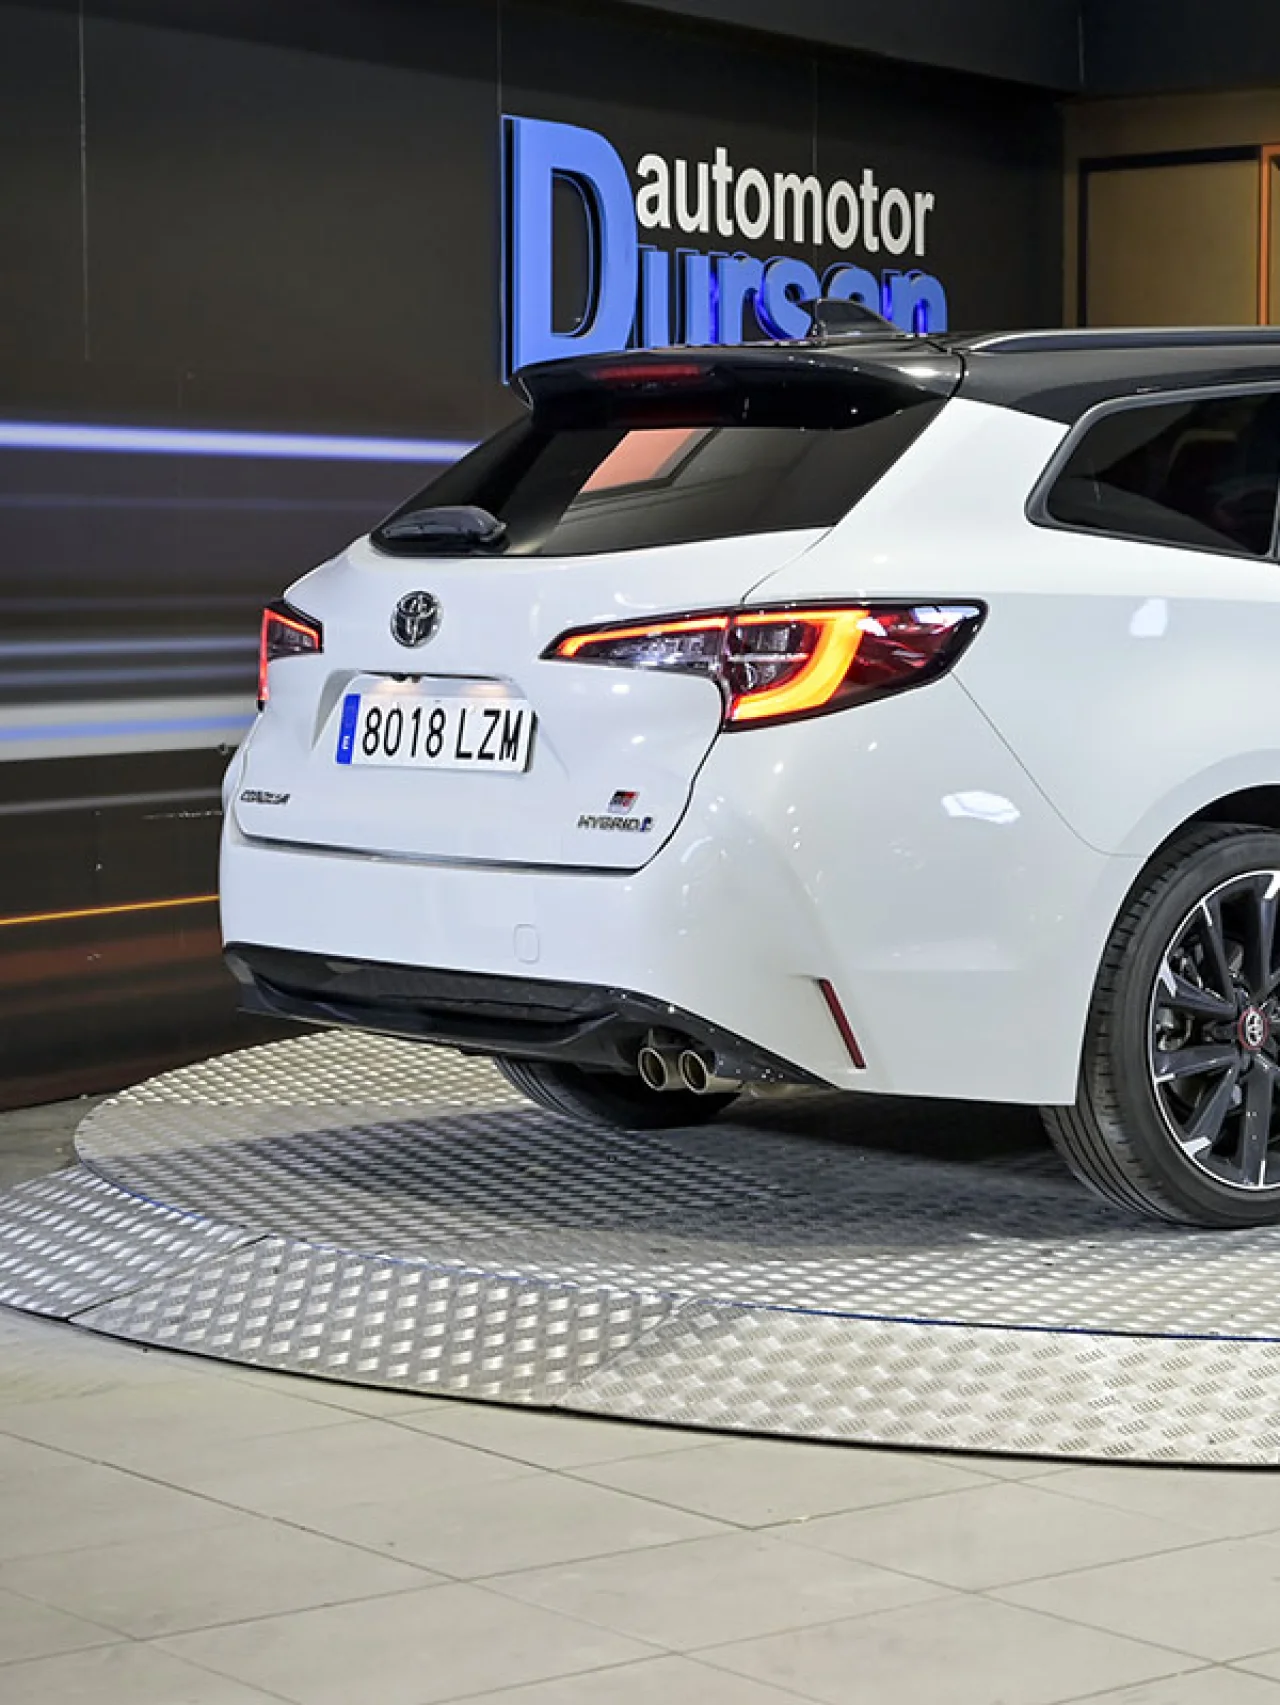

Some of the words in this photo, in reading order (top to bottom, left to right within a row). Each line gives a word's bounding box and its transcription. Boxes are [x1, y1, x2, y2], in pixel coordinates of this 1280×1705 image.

[636, 147, 934, 256] automotor
[362, 706, 446, 758] 8018
[455, 708, 523, 762] LZM
[577, 814, 641, 833] HYBRID
